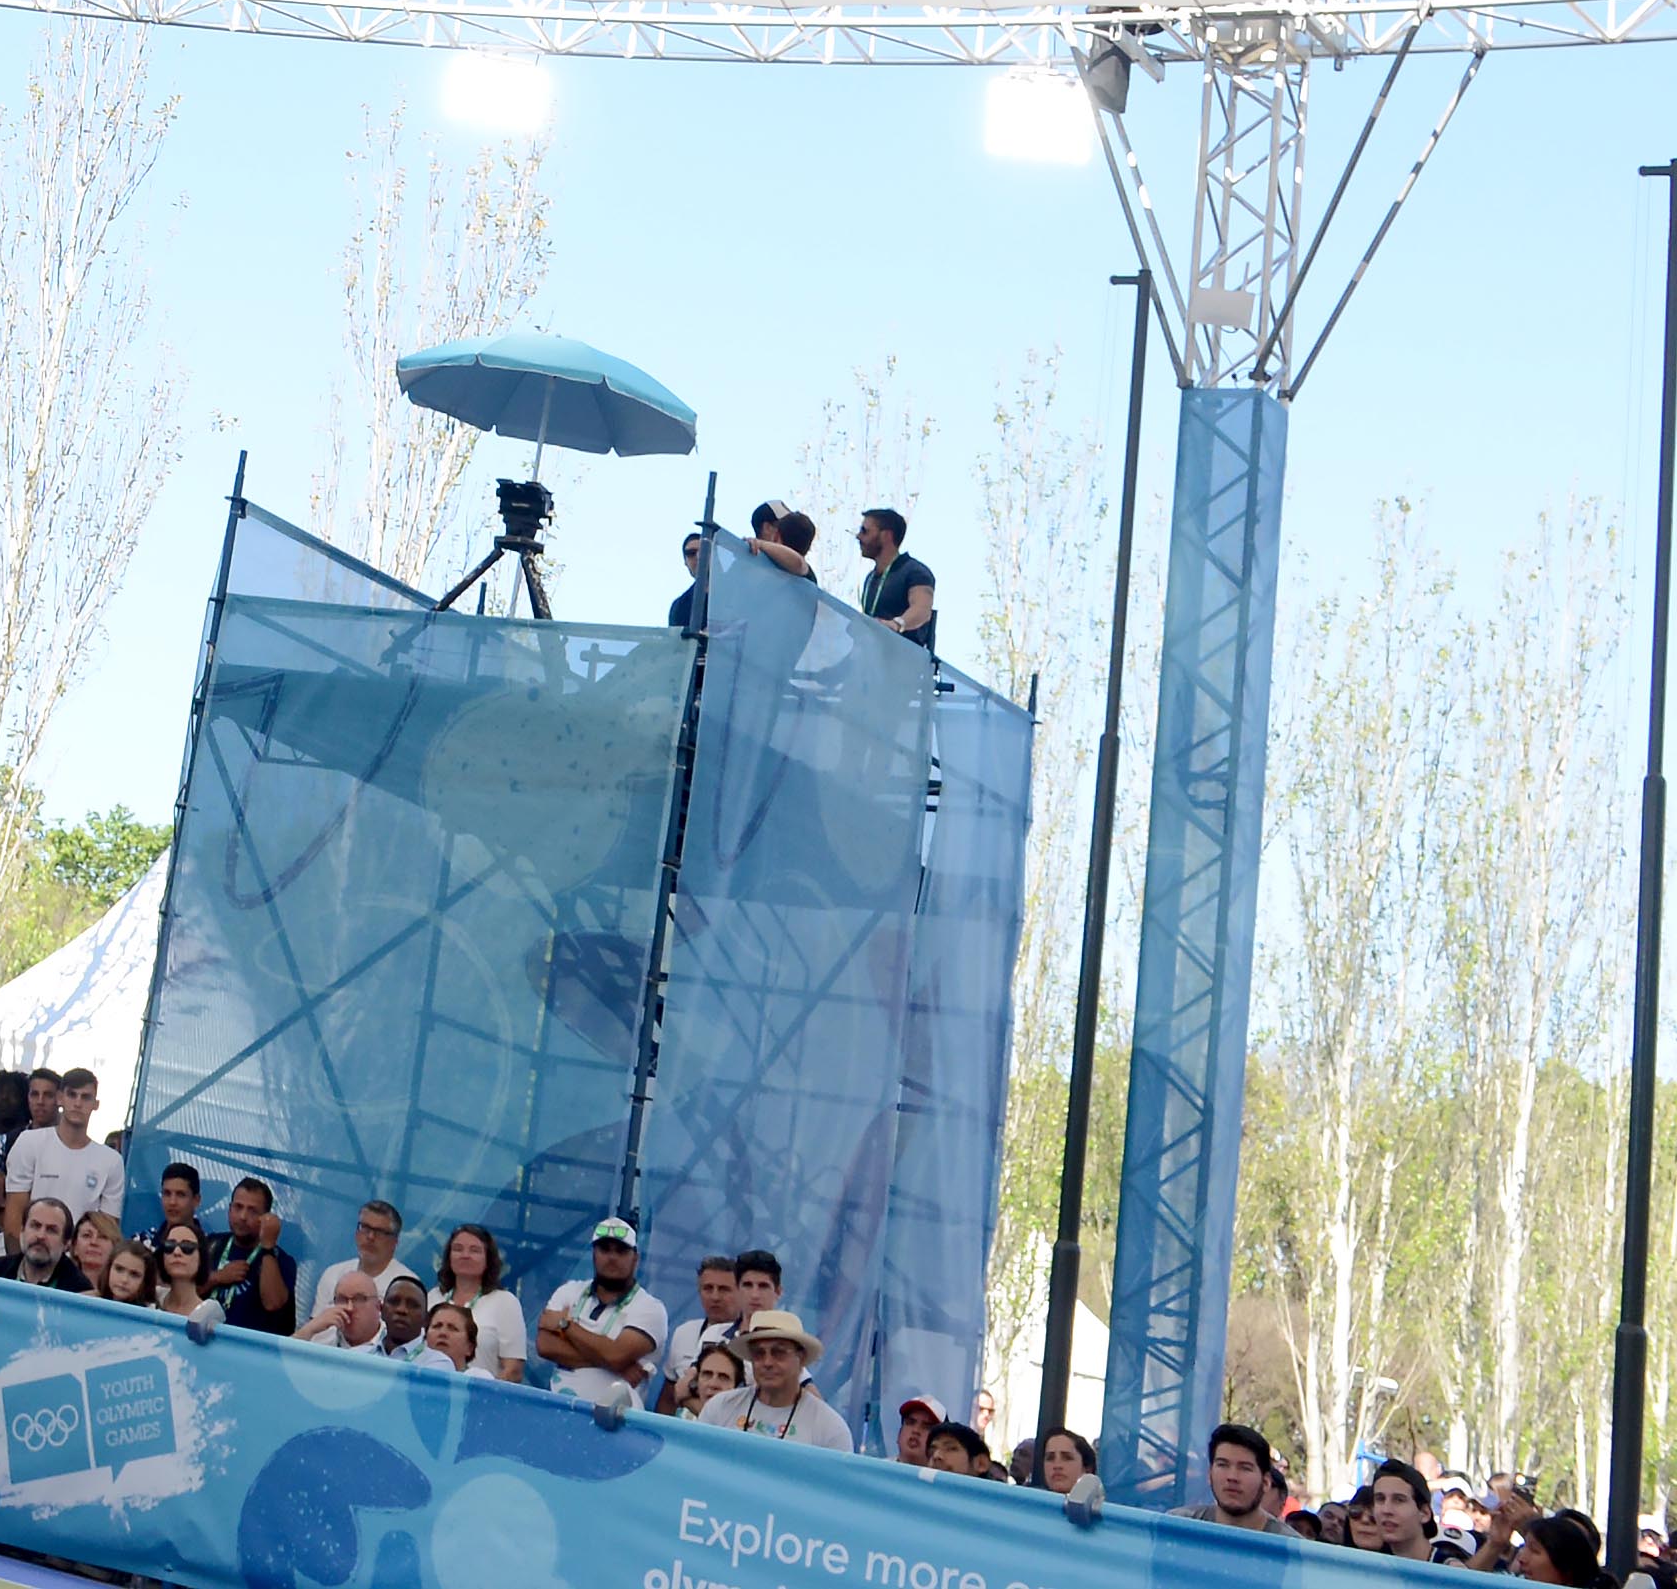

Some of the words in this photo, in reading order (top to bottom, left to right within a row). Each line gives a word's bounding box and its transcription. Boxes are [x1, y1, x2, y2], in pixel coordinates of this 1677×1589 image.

[100, 1373, 155, 1400] YOUTH
[96, 1396, 165, 1425] OLYMPIC
[106, 1421, 162, 1447] GAMES
[679, 1497, 850, 1574] Explore
